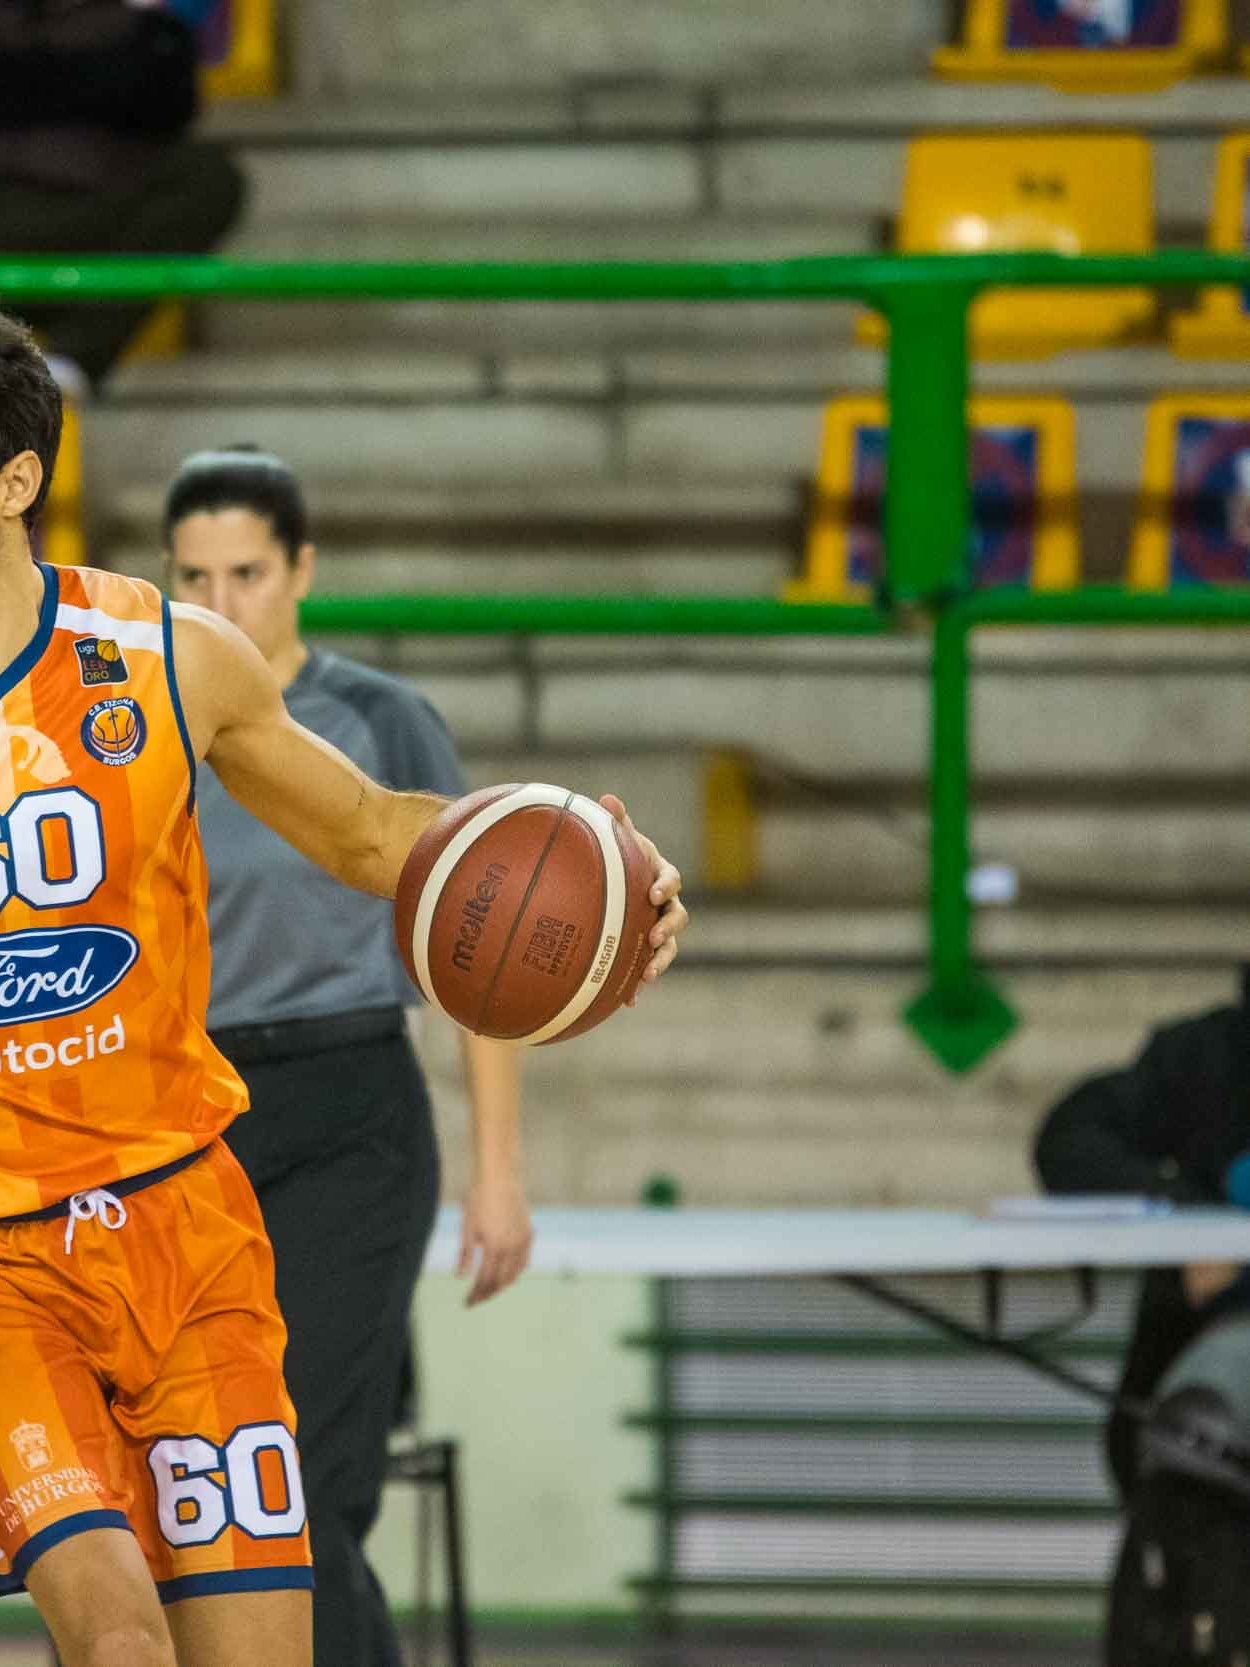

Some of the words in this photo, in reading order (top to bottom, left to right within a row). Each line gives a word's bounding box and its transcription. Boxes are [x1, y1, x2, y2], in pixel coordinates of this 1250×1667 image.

[83, 658, 108, 670] LEB
[84, 670, 110, 681] ORO
[103, 698, 134, 709] TIZONA
[102, 752, 136, 766] BURGOS
[452, 863, 510, 973] molten
[548, 923, 576, 976] APPROVED
[591, 935, 616, 983] BG4500
[147, 1420, 307, 1549] 60
[5, 1511, 23, 1533] DE
